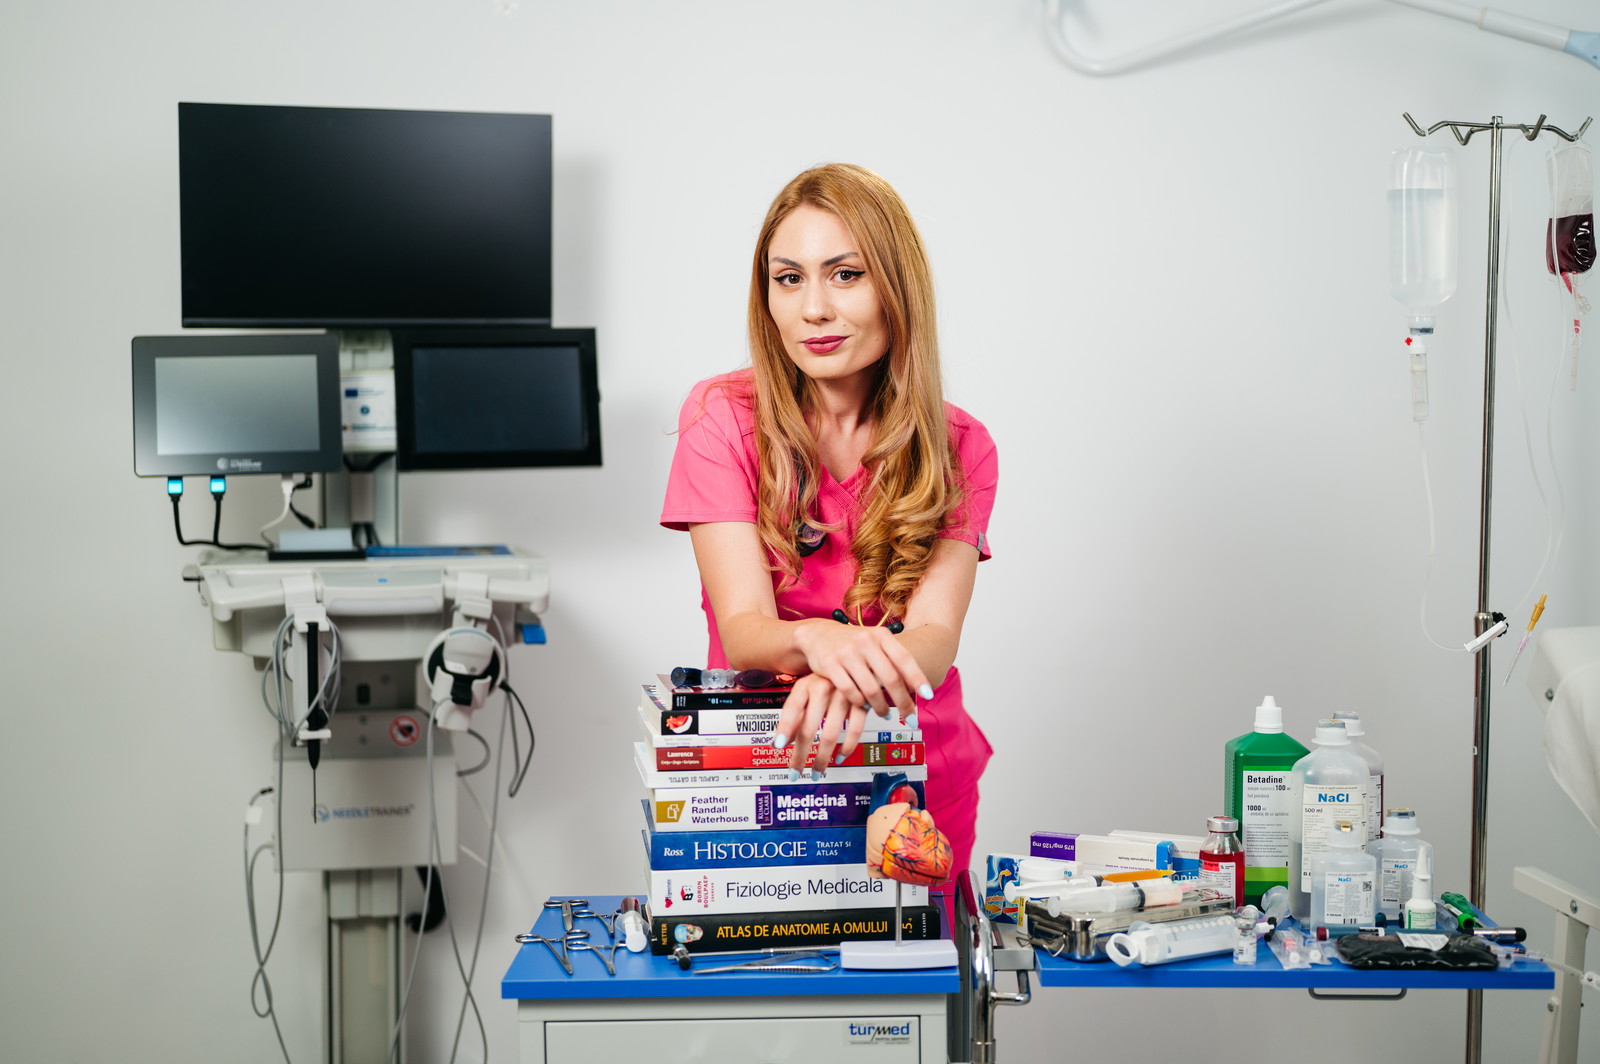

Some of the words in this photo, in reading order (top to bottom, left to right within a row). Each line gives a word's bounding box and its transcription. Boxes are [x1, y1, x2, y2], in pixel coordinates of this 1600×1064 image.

[736, 720, 780, 732] MEDICINA
[752, 746, 784, 757] Chirurgie
[1247, 775, 1283, 784] Betadine
[692, 796, 728, 804] Feather
[777, 794, 848, 808] Medicină
[1318, 793, 1349, 802] NaCl
[692, 806, 728, 814] Randall
[777, 808, 828, 822] clinică
[692, 815, 750, 824] Waterhouse
[694, 841, 808, 860] HISTOLOGIE
[726, 880, 802, 900] Fiziologie
[716, 926, 751, 938] ATLAS
[754, 925, 769, 937] DE
[772, 922, 830, 936] ANATOMIE
[832, 922, 841, 934] A
[843, 921, 888, 934] OMULUI
[848, 1022, 910, 1040] turmed
